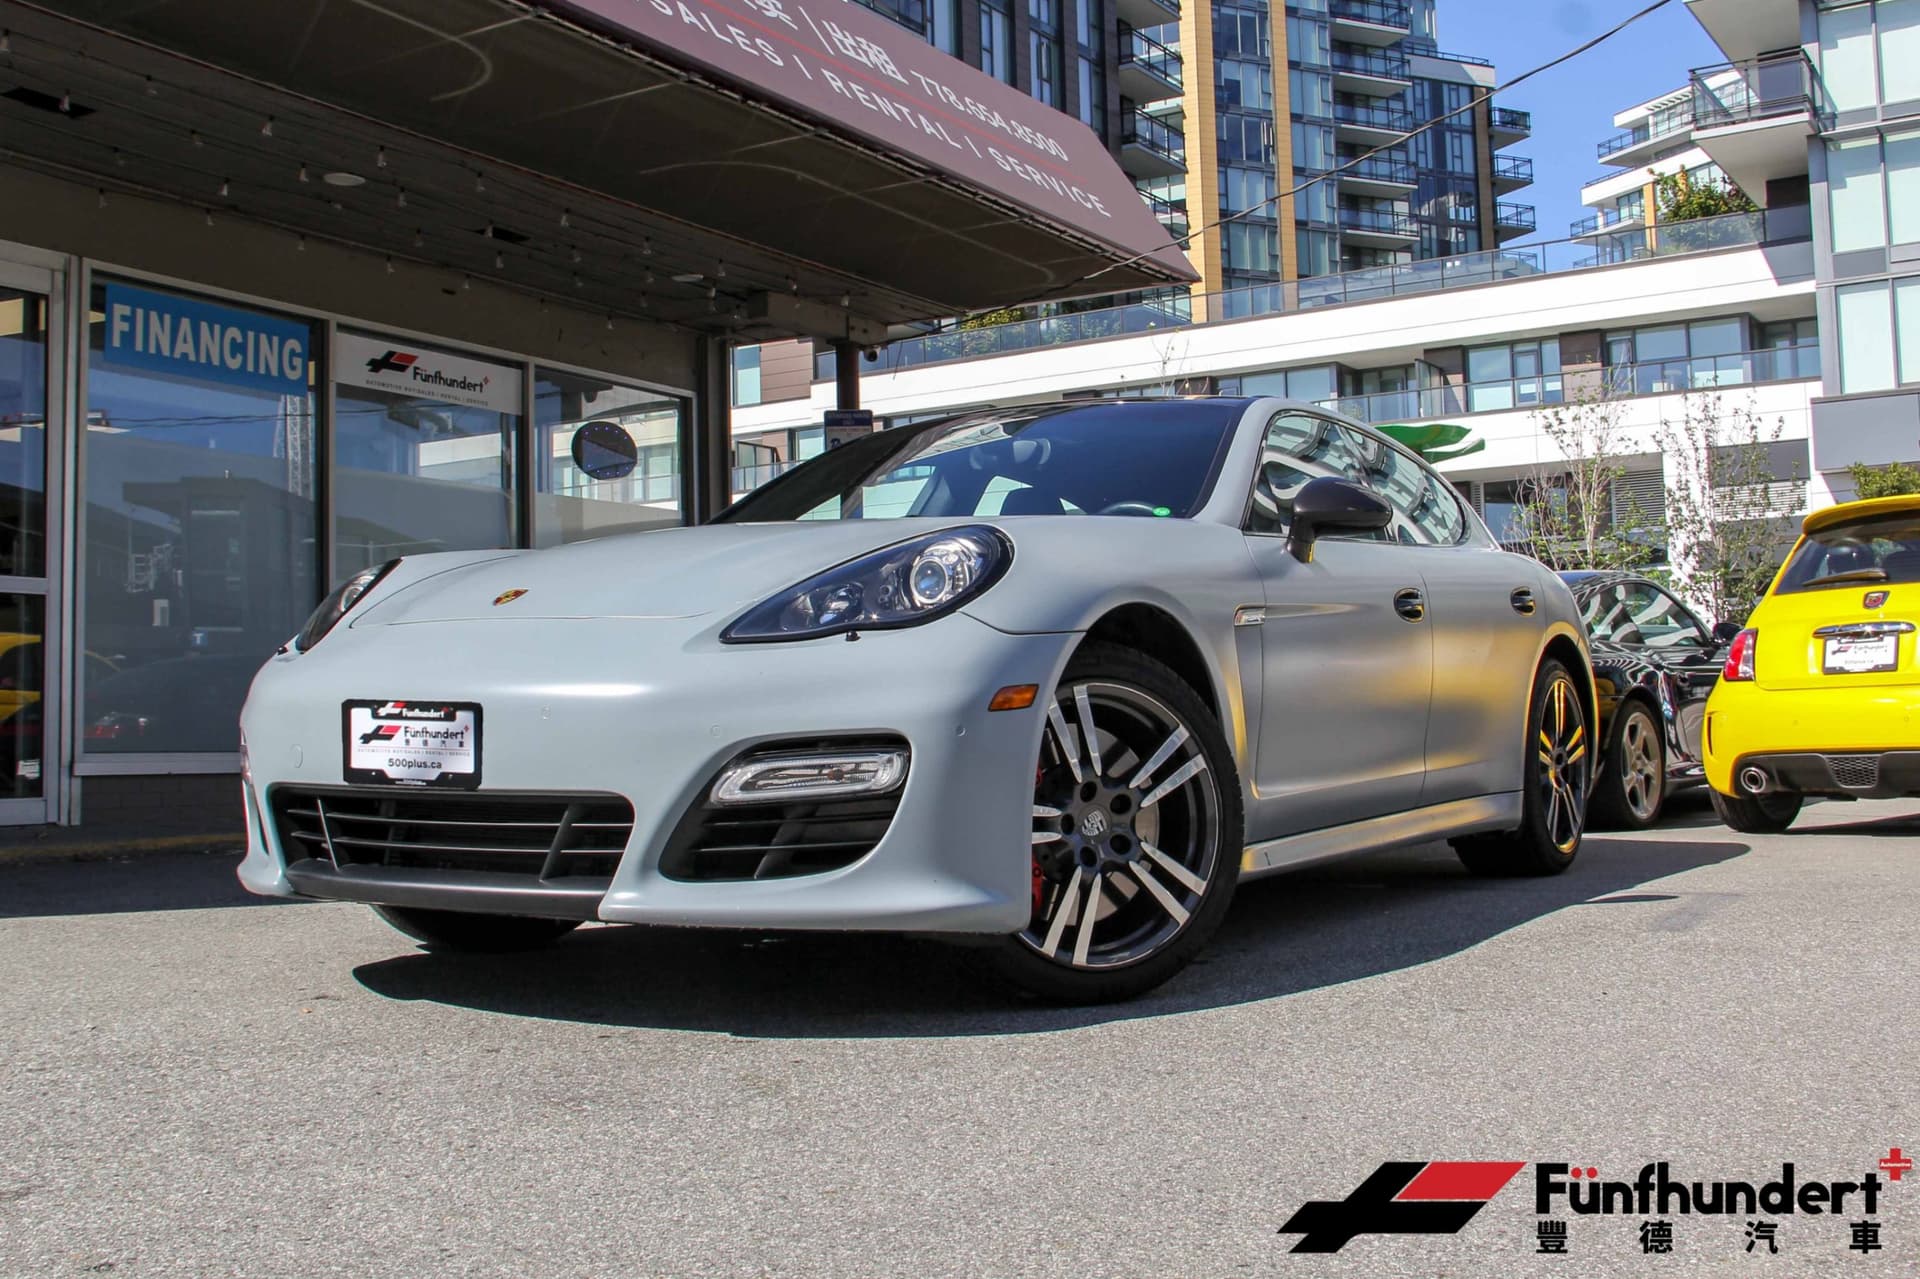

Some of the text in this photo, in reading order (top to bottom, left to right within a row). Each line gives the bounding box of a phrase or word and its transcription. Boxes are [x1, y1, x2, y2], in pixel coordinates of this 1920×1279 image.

[648, 0, 1112, 218] SALES RENTAL SERVICE
[821, 20, 909, 85] 出租
[910, 70, 1069, 162] 778.654.8500
[111, 302, 303, 380] FINANCING
[412, 366, 484, 393] Fünfhundert
[388, 757, 442, 770] 500plus.ca
